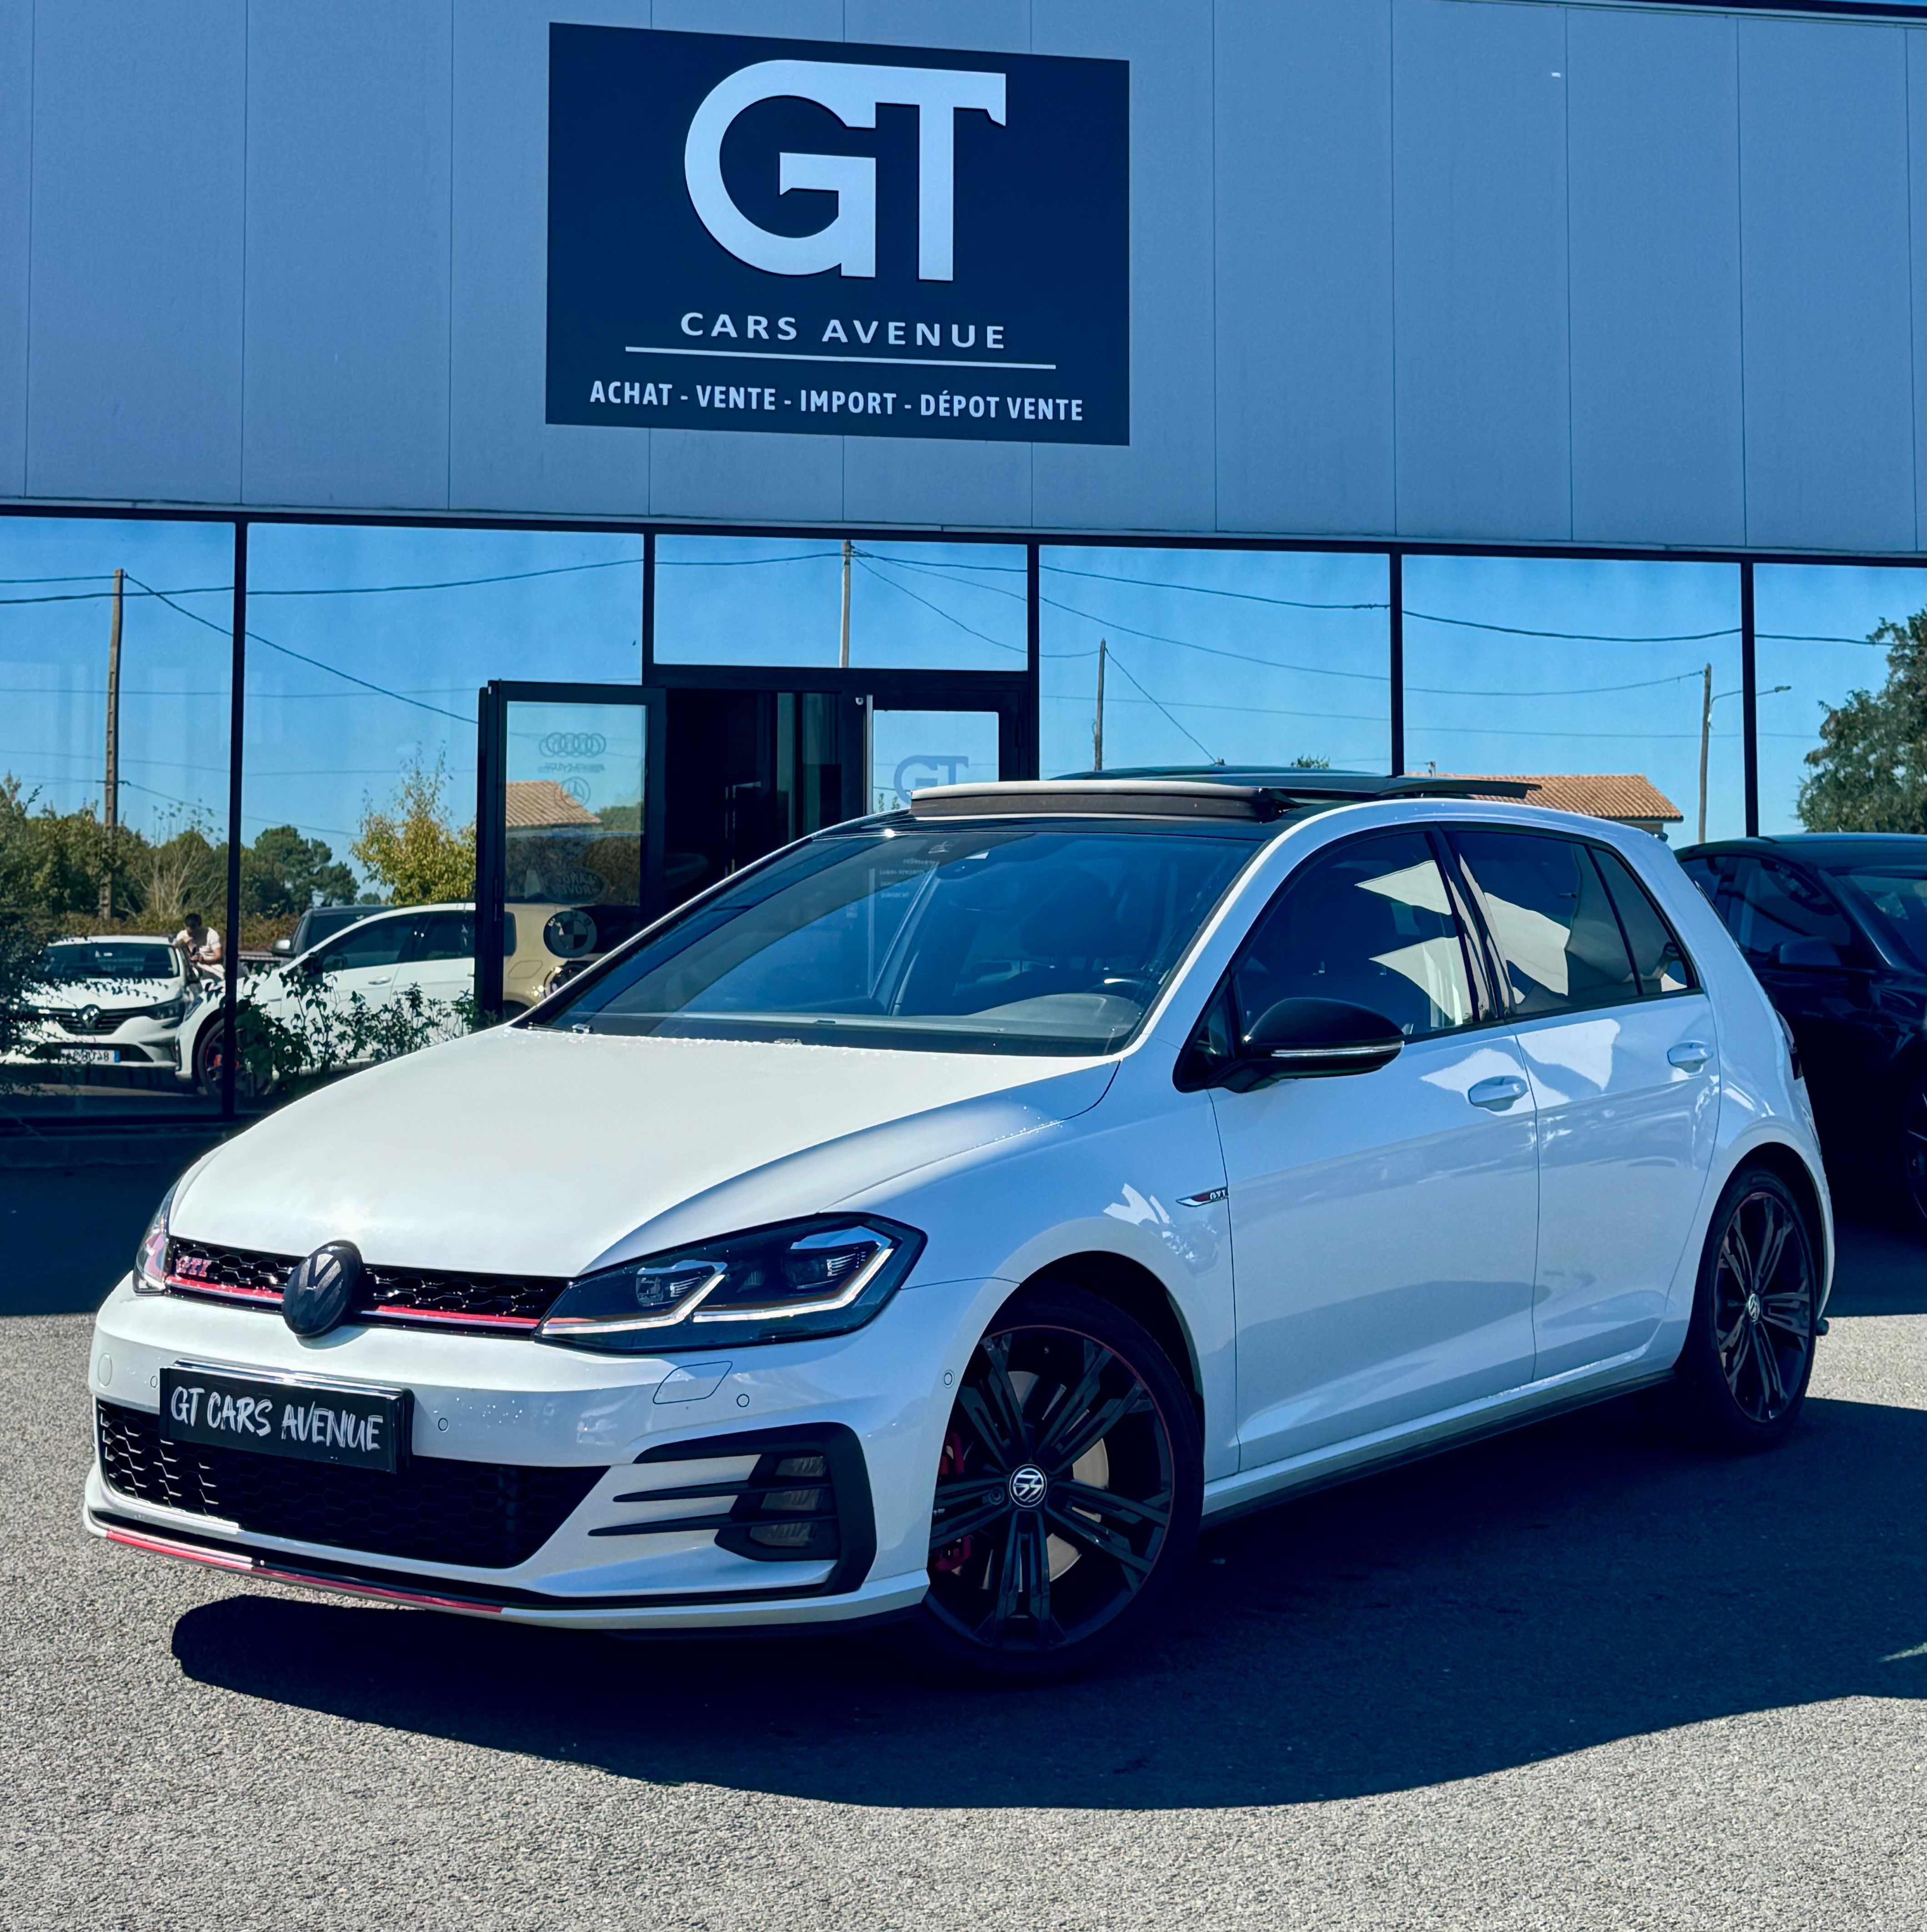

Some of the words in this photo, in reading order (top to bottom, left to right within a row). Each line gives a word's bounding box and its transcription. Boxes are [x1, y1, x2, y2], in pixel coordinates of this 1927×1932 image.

[684, 59, 1006, 281] GT
[680, 312, 798, 341] CARS
[821, 319, 1004, 349] AVENUE
[590, 380, 673, 406] ACHAT
[696, 385, 776, 411] VENTE
[800, 389, 897, 415] IMPORT
[921, 389, 1000, 418] DÉPOT
[1006, 397, 1083, 421] VENTE
[171, 1385, 205, 1427] GT
[207, 1391, 273, 1437] CARS
[281, 1400, 384, 1452] AVENUE
